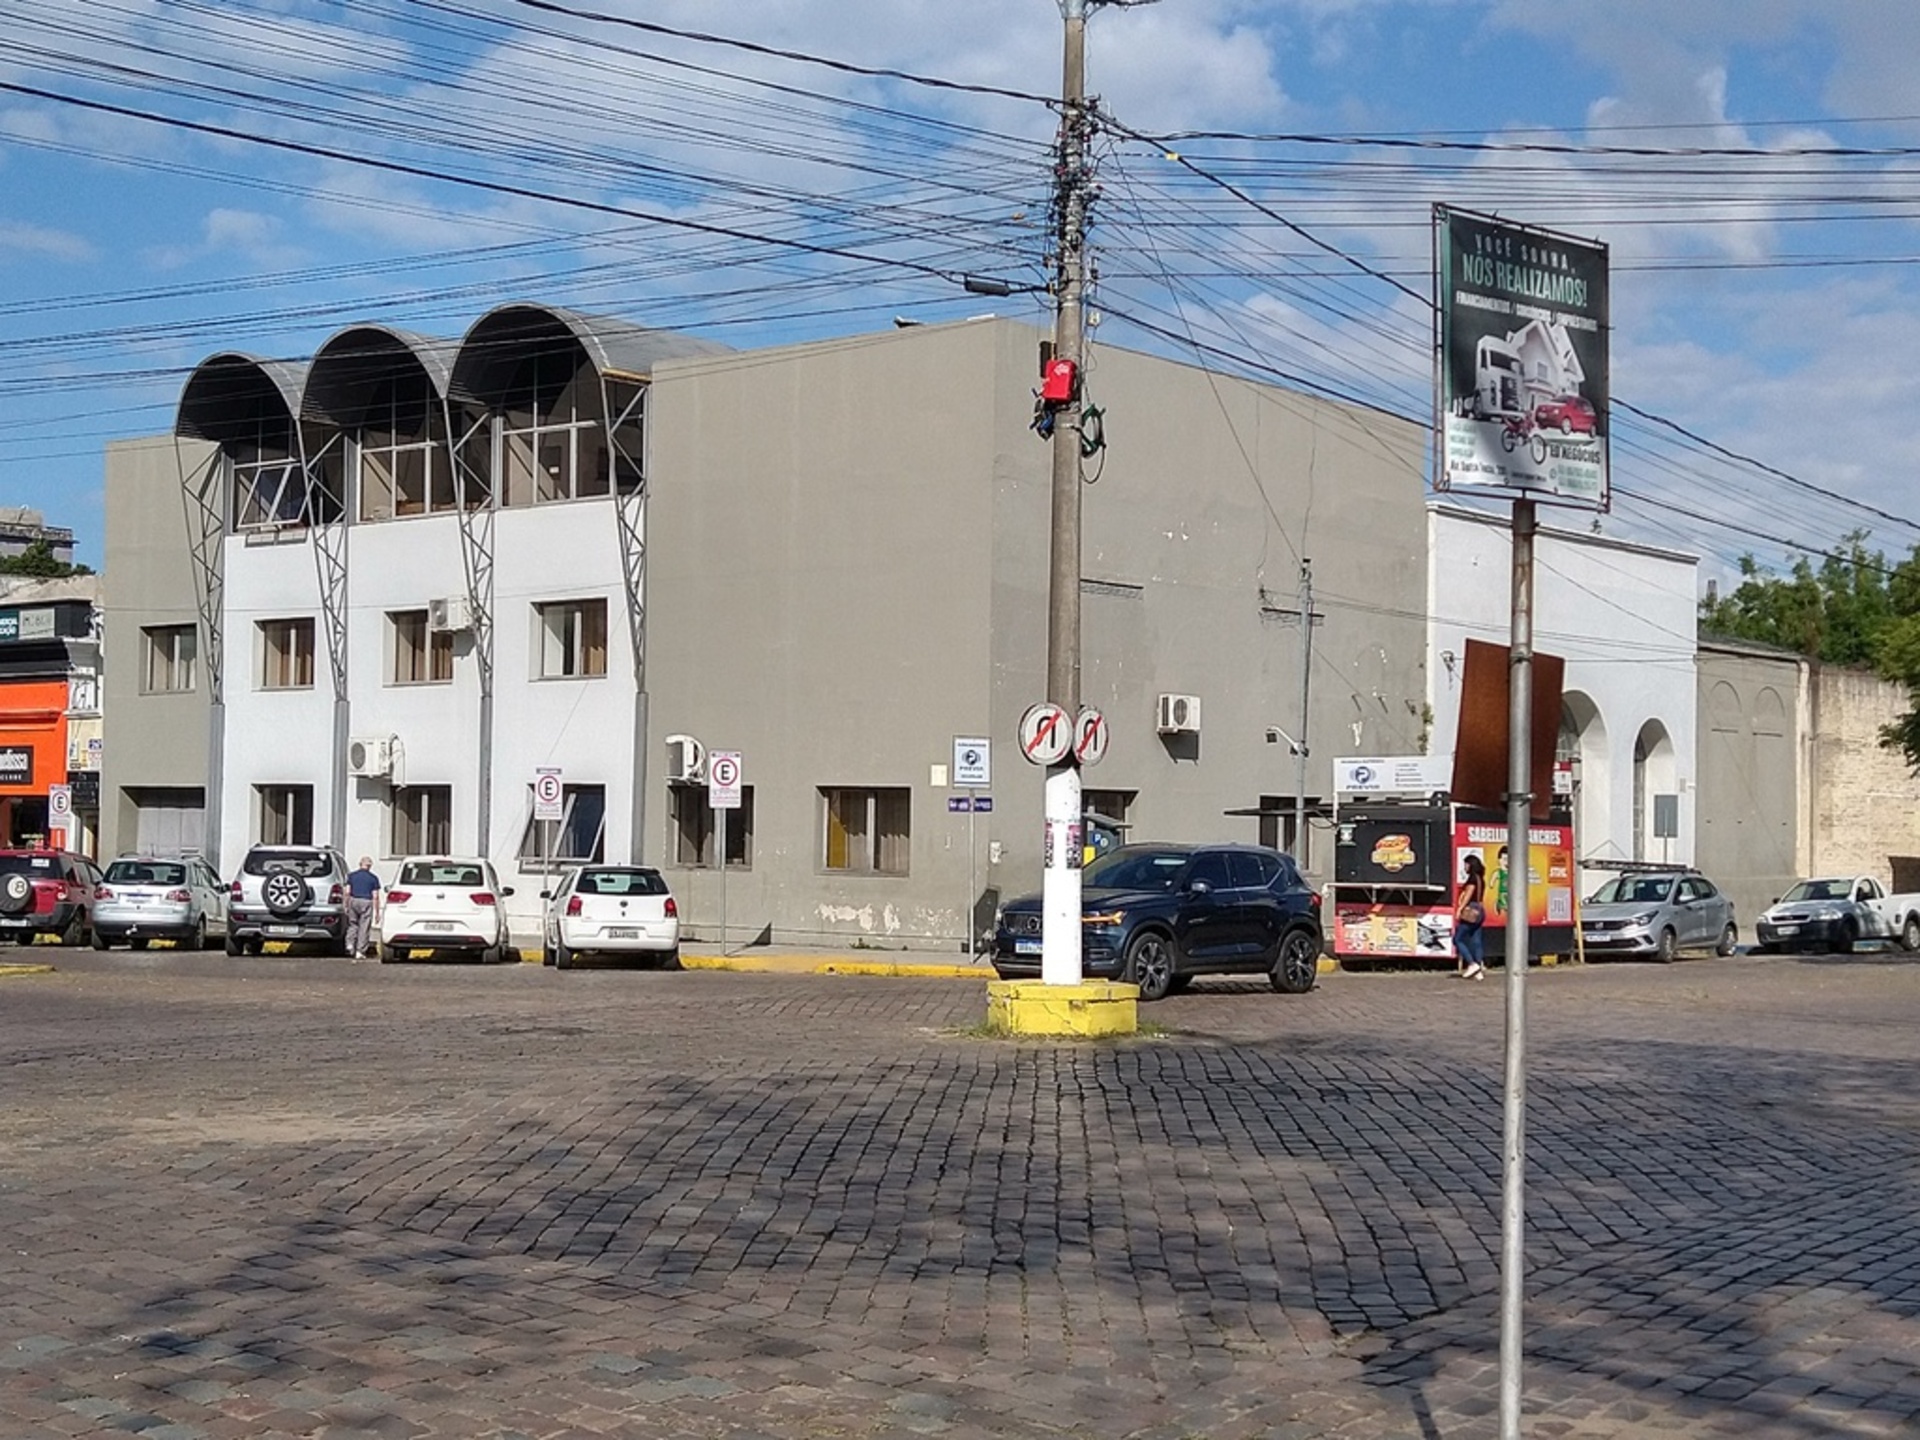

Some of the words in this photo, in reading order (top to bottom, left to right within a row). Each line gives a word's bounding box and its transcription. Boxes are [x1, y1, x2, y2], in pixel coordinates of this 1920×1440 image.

[1462, 250, 1494, 287] NÓS
[1496, 261, 1588, 308] REALIZAMOS!
[721, 764, 730, 780] E
[545, 781, 553, 796] E
[1527, 829, 1561, 845] ANCHES
